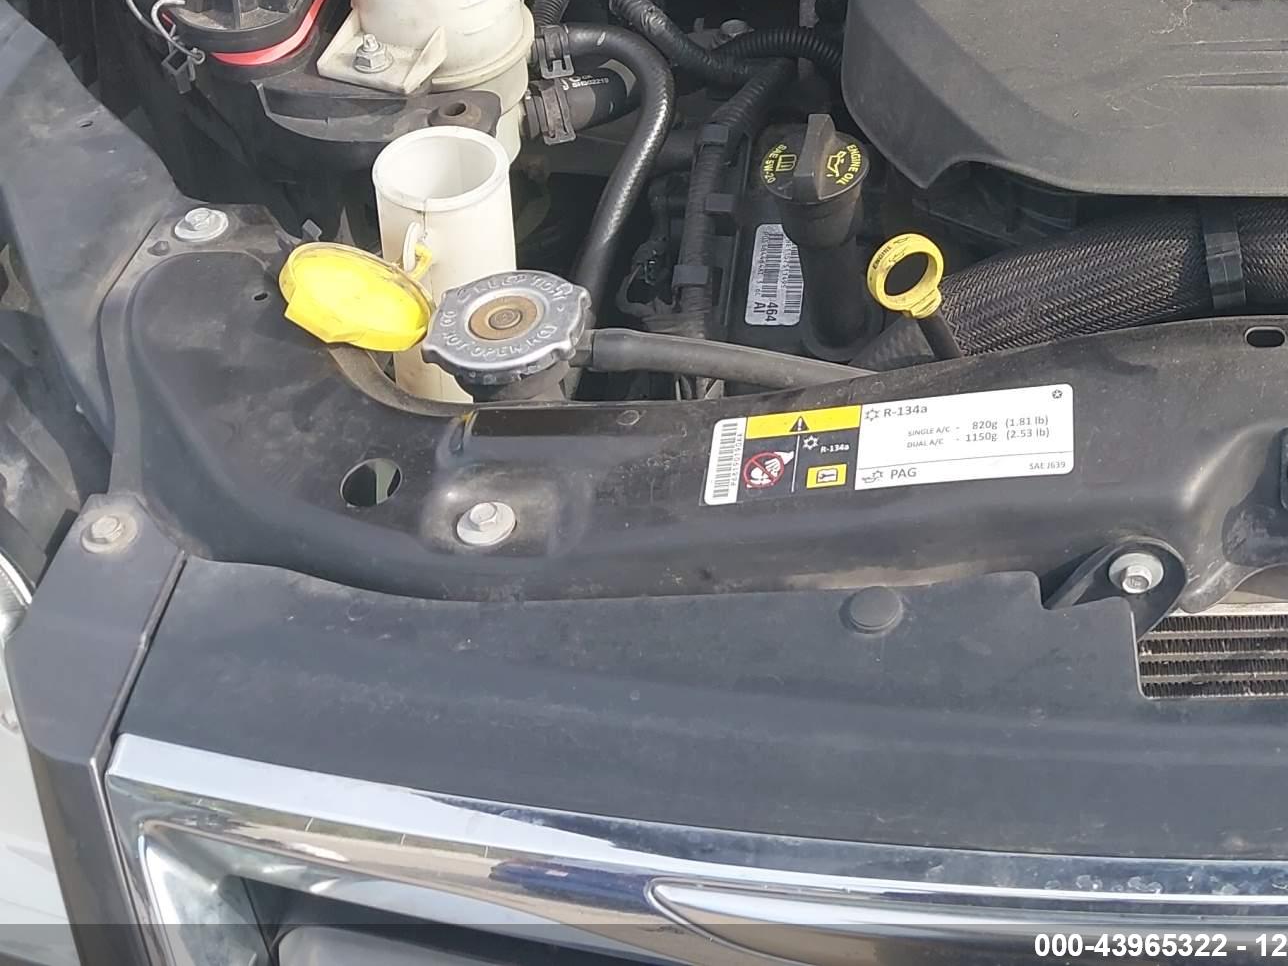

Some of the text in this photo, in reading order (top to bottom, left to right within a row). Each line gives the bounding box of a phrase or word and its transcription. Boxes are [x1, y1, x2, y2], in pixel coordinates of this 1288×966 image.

[762, 144, 787, 184] SAE 5W-20
[836, 144, 862, 186] ENGINE OIL
[765, 301, 779, 322] 464
[883, 404, 928, 418] R-134a
[936, 425, 951, 434] A/C
[971, 420, 998, 433] 820g
[1005, 417, 1032, 430] (1.81
[1035, 415, 1050, 427] lb)
[928, 437, 945, 446] A/C
[965, 431, 998, 443] 1150g
[1005, 427, 1033, 441] (2.53
[1035, 425, 1050, 438] lb)
[820, 443, 850, 454] R-134a
[890, 467, 917, 480] PAG
[1028, 462, 1044, 471] SAE
